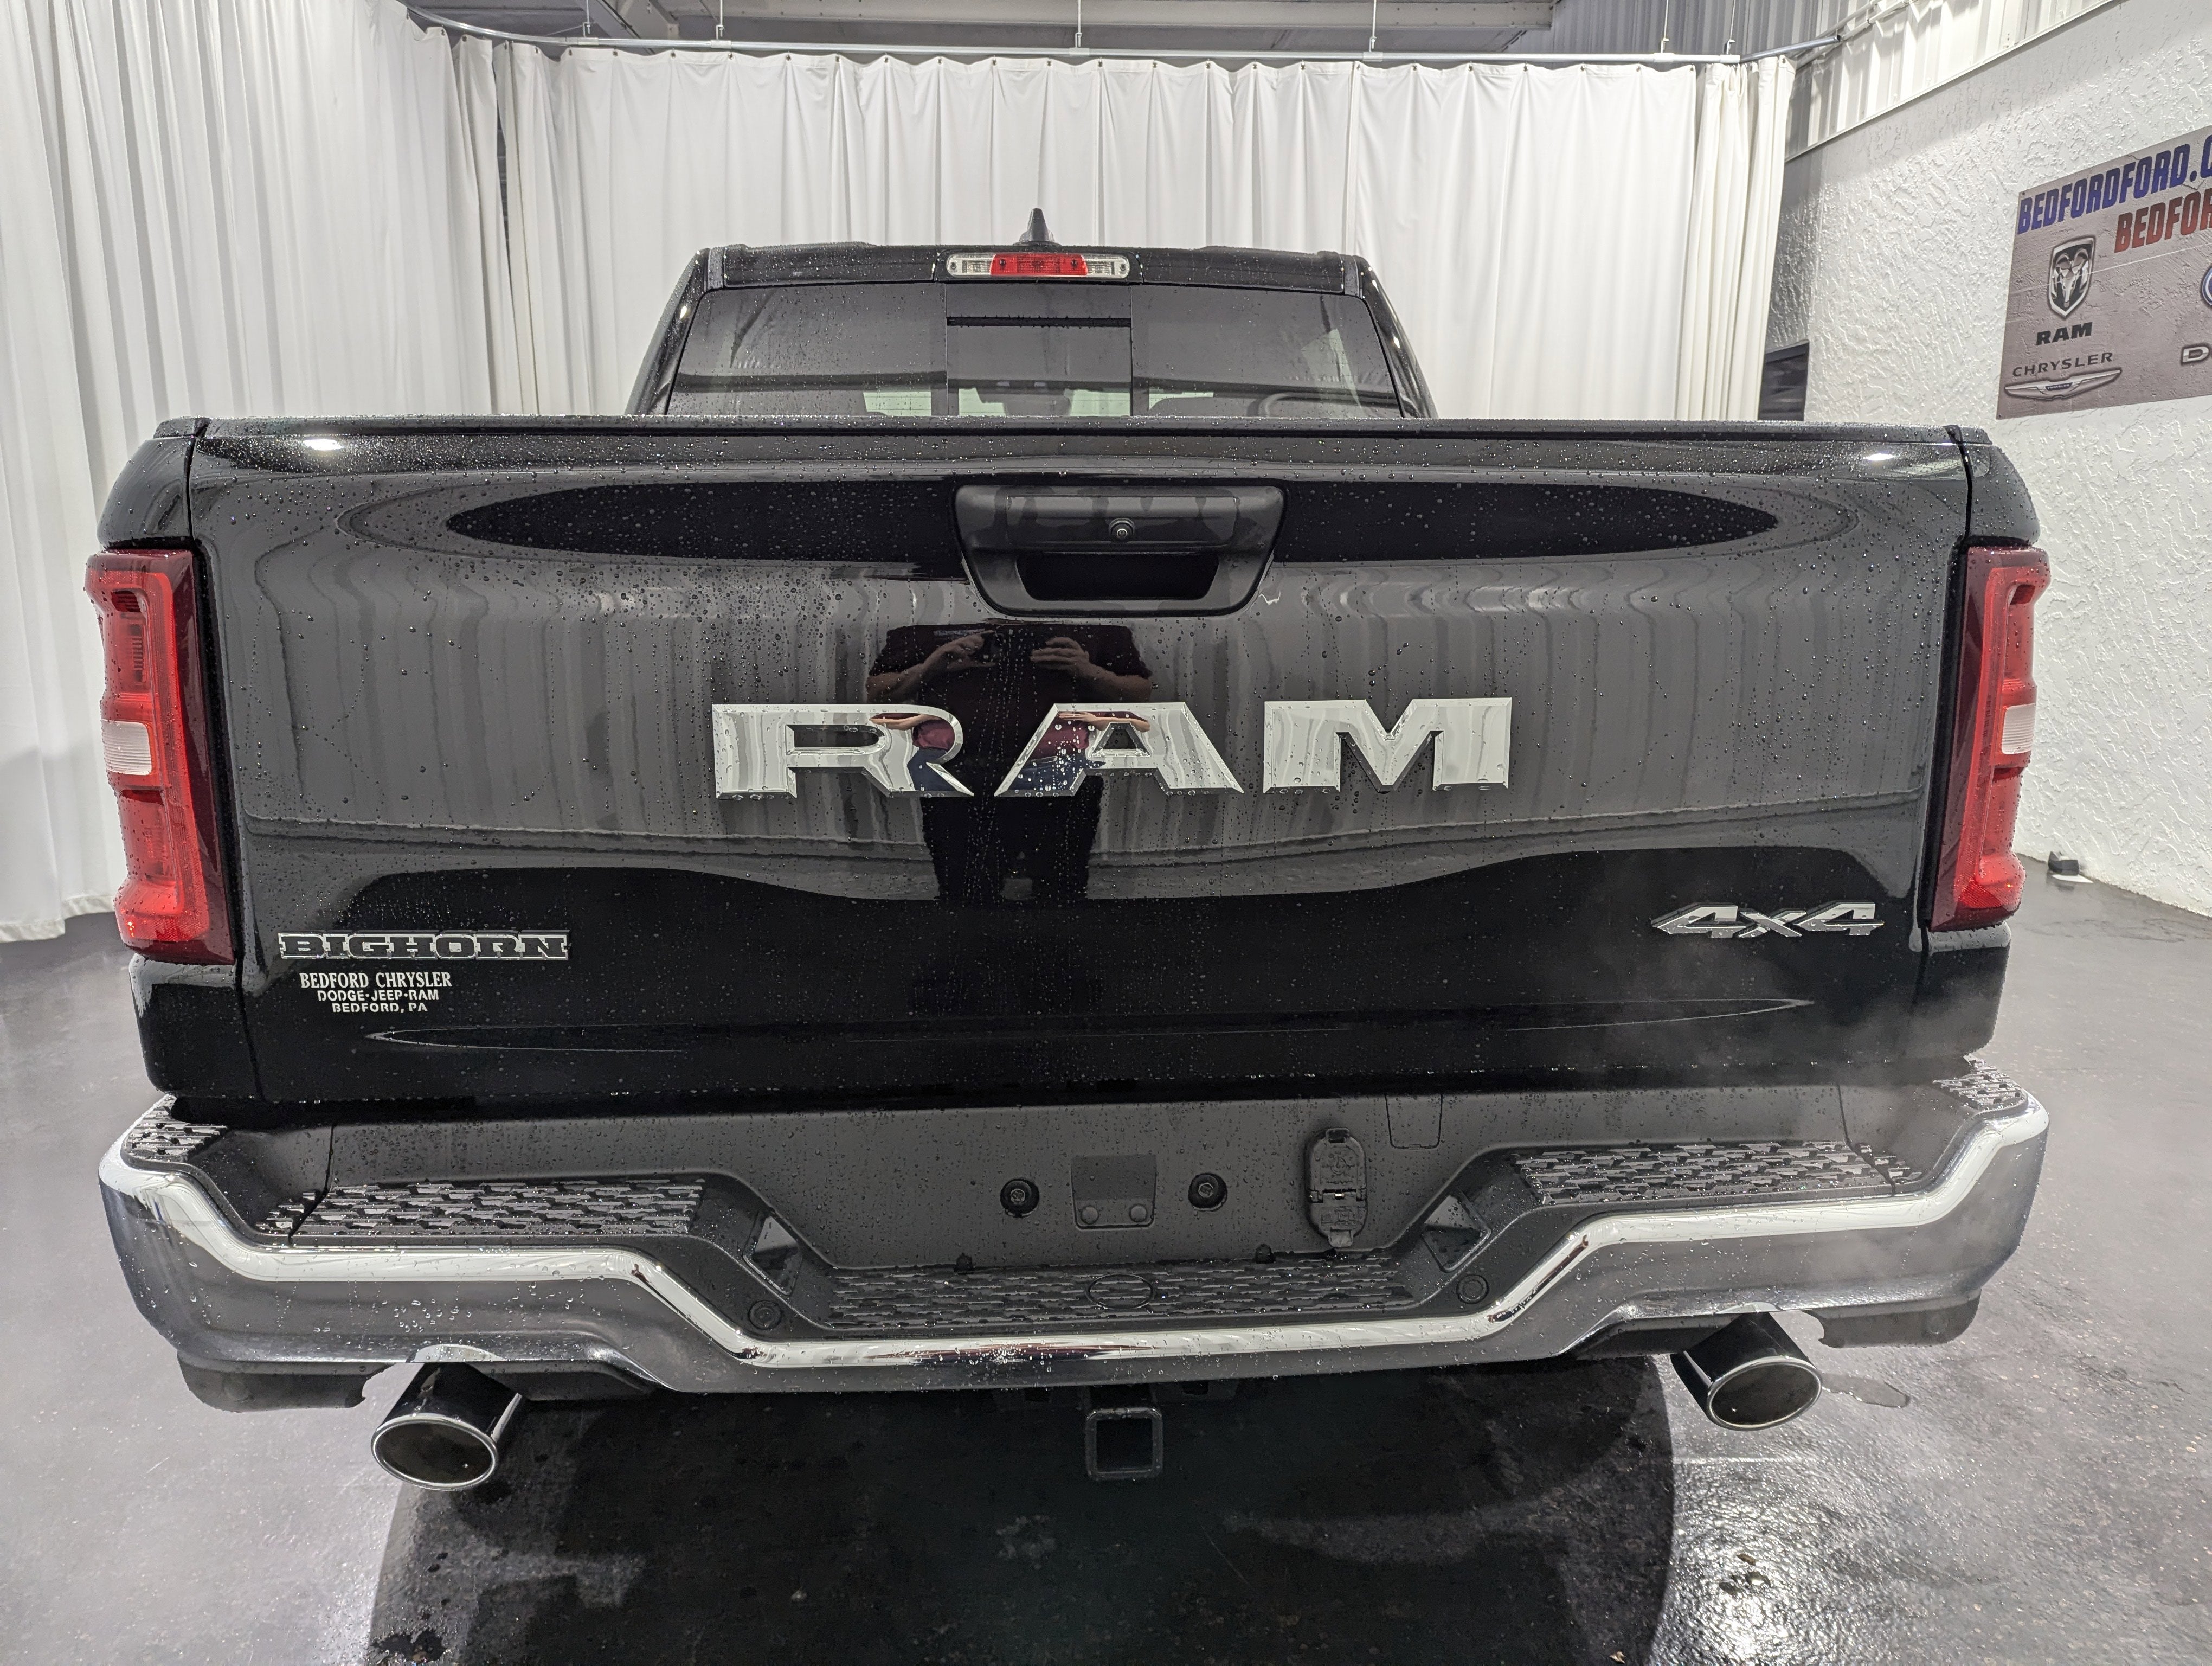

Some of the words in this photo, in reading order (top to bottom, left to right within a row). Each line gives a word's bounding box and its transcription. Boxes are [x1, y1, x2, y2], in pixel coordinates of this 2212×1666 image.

[2036, 322, 2093, 345] RAM
[2012, 352, 2113, 377] CHRYSLER
[711, 697, 1513, 798] RAM
[278, 930, 569, 960] BIGHORN
[300, 972, 369, 988] BEDFORD
[376, 972, 452, 988] CHRYSLER
[332, 1003, 404, 1013] BEDFORD,
[408, 1002, 428, 1012] PA
